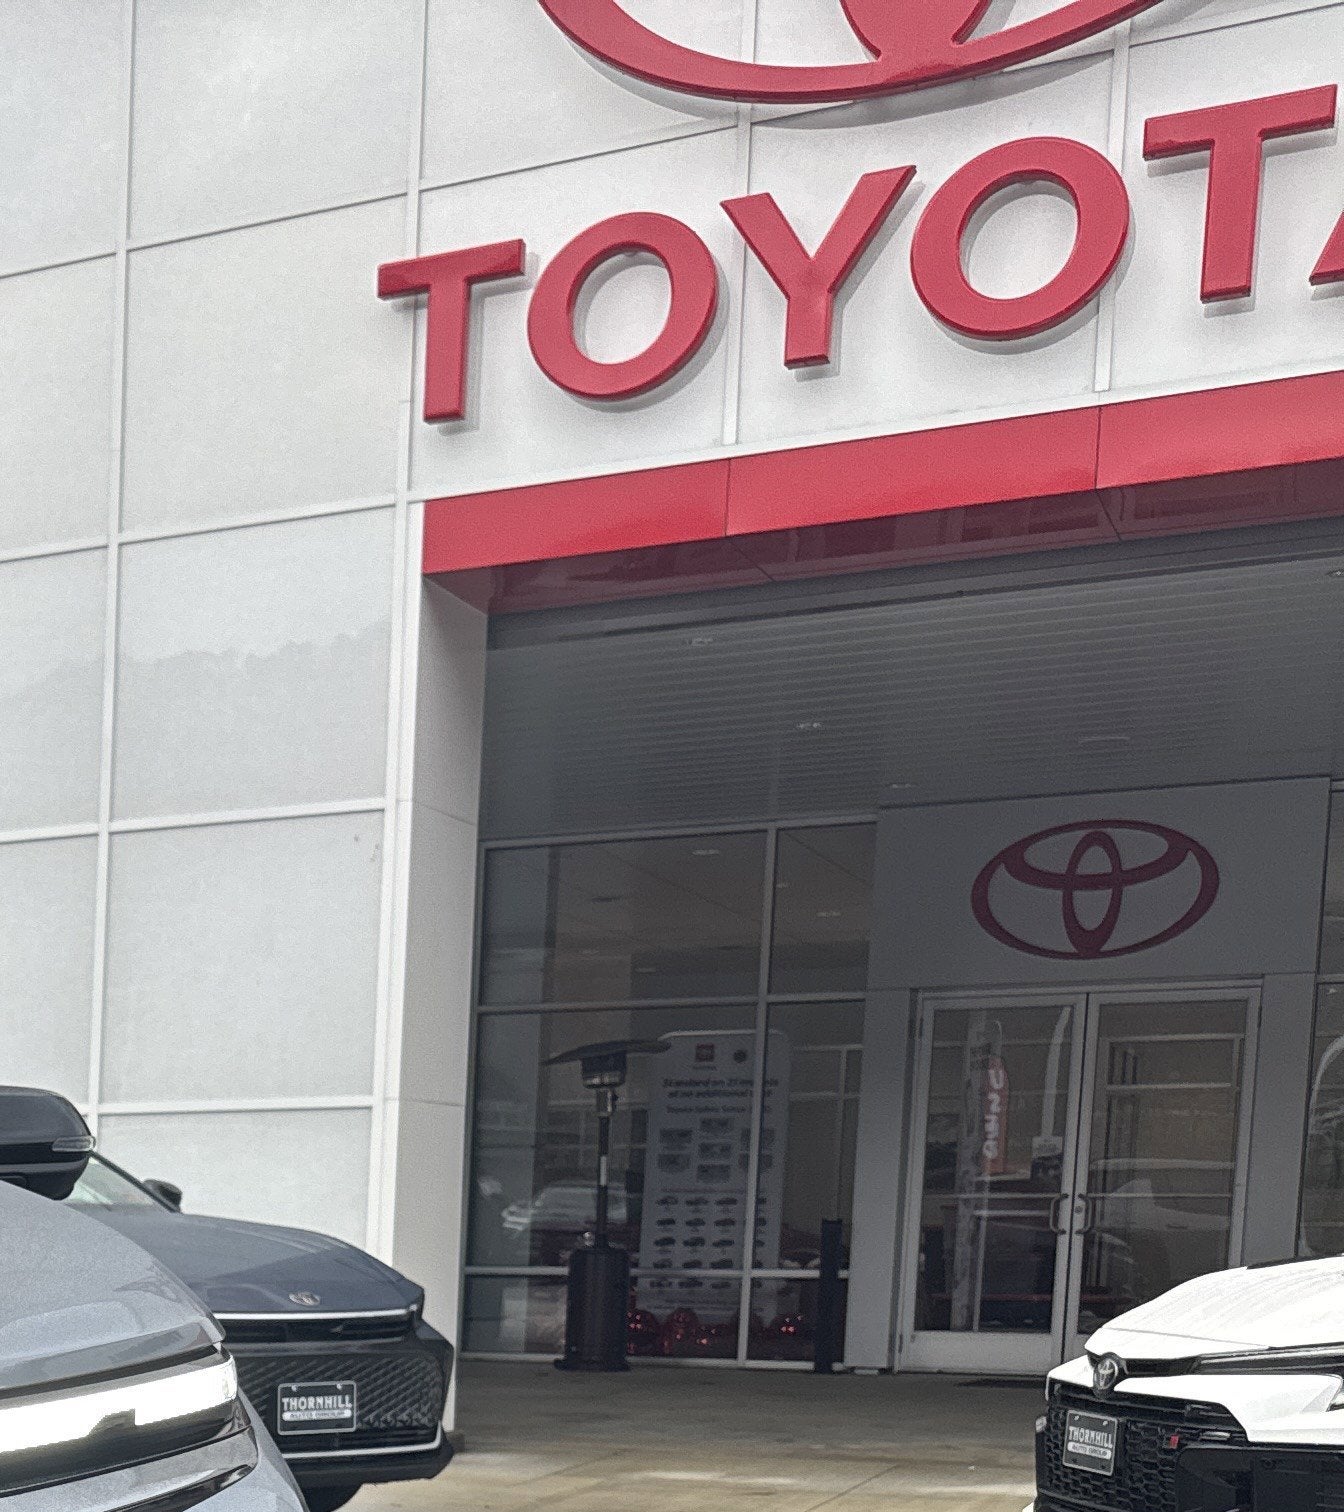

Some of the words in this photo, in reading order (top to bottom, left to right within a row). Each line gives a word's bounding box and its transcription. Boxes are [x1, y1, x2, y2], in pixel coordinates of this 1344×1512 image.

[377, 83, 1344, 424] TOYOT
[281, 1394, 353, 1412] THORNHILL
[1068, 1425, 1113, 1449] THORNHILL
